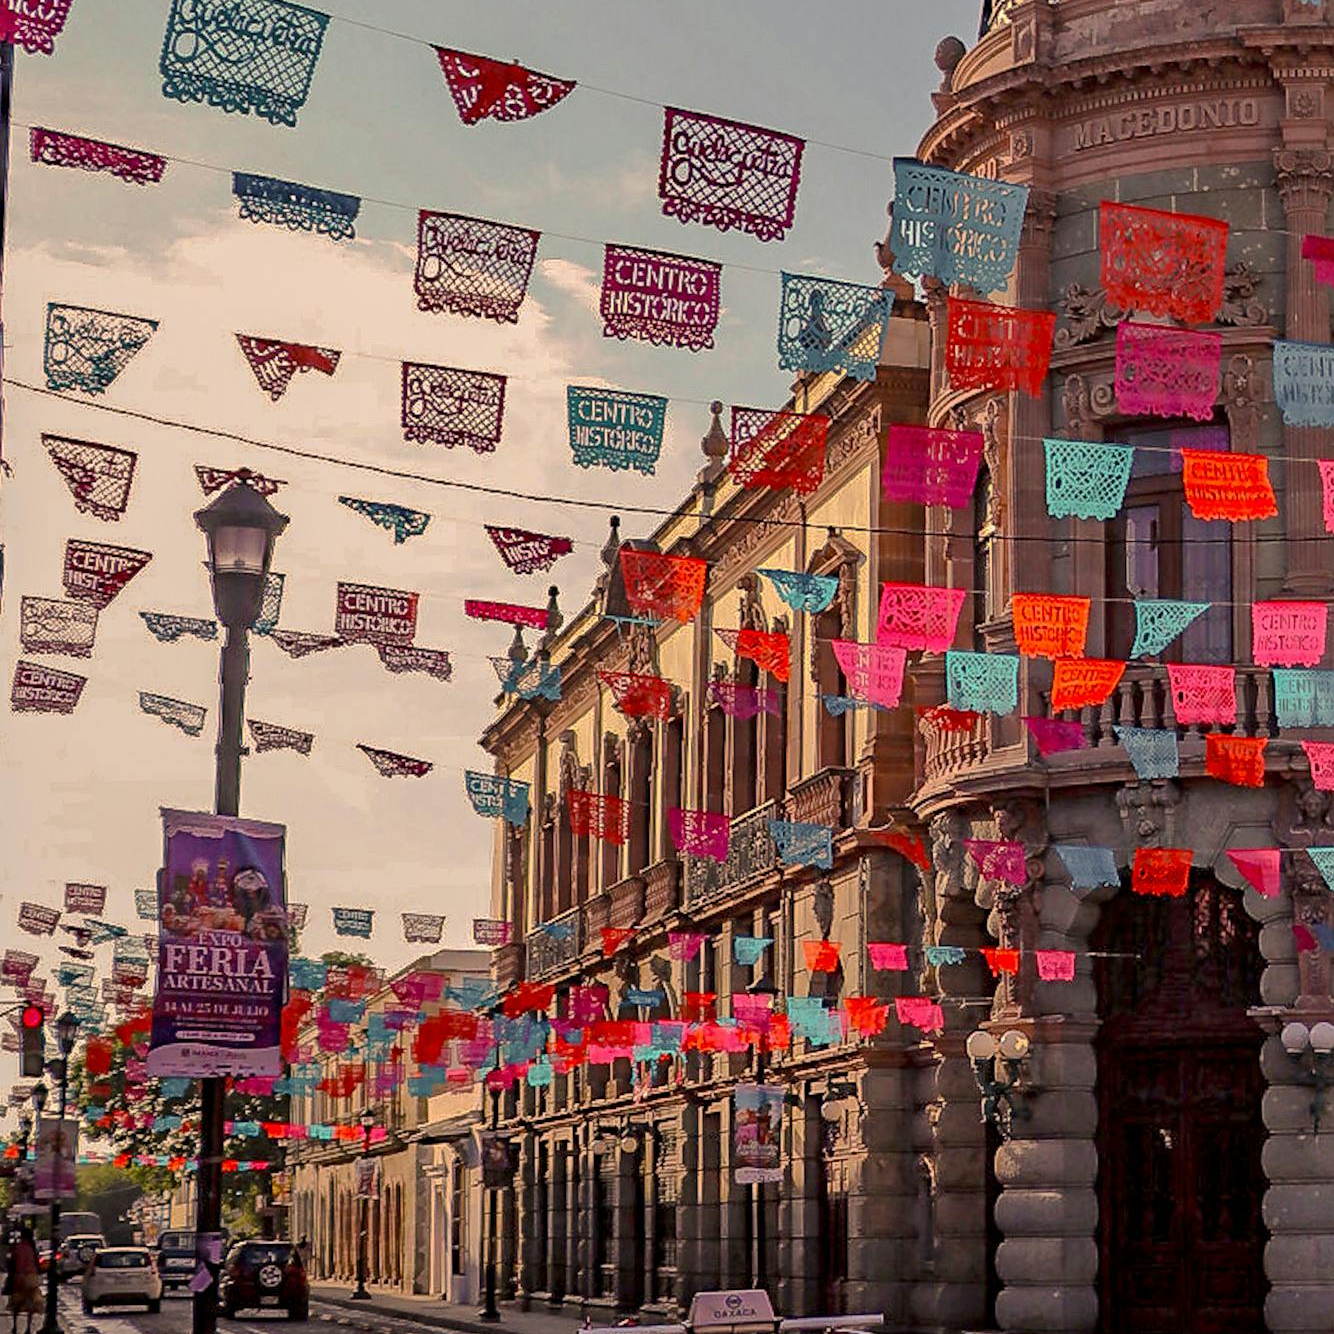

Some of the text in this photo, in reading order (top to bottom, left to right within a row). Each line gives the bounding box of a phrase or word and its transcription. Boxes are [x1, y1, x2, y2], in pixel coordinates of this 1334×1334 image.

[1074, 98, 1260, 152] MACEDONIO
[904, 185, 1009, 230] CENTRO
[613, 260, 709, 297] CENTRO
[609, 290, 712, 326] HISTÓRICO
[577, 399, 654, 431] CENTRO
[344, 593, 410, 615] CENTRO
[1021, 605, 1080, 624] CENTRO
[1261, 615, 1320, 631] CENTRO
[198, 932, 243, 948] EXPO
[163, 944, 276, 978] FERIA
[163, 975, 275, 994] ARTESANAL
[231, 1004, 270, 1017] JULIO
[713, 1309, 758, 1322] OAXACA
